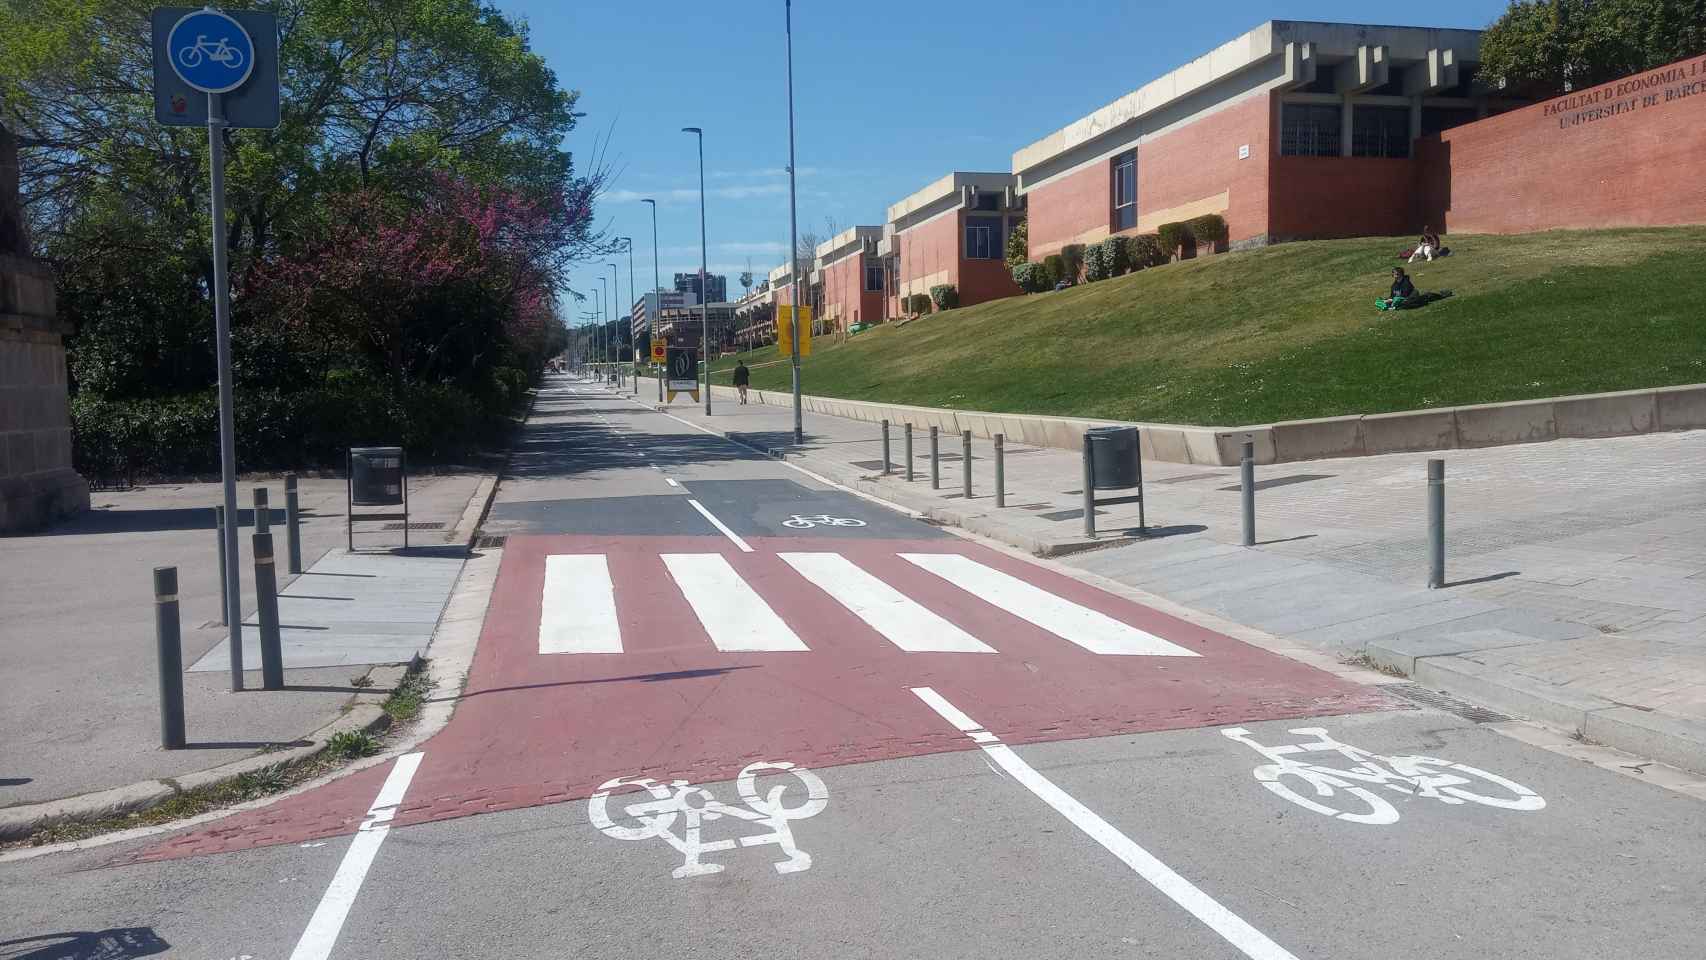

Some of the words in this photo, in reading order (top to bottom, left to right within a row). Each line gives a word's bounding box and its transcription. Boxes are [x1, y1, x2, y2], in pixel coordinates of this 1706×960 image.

[1544, 91, 1601, 116] FACULTAT
[1690, 63, 1697, 76] I
[1560, 99, 1638, 129] UNIVERSITAT
[1642, 93, 1660, 108] DE
